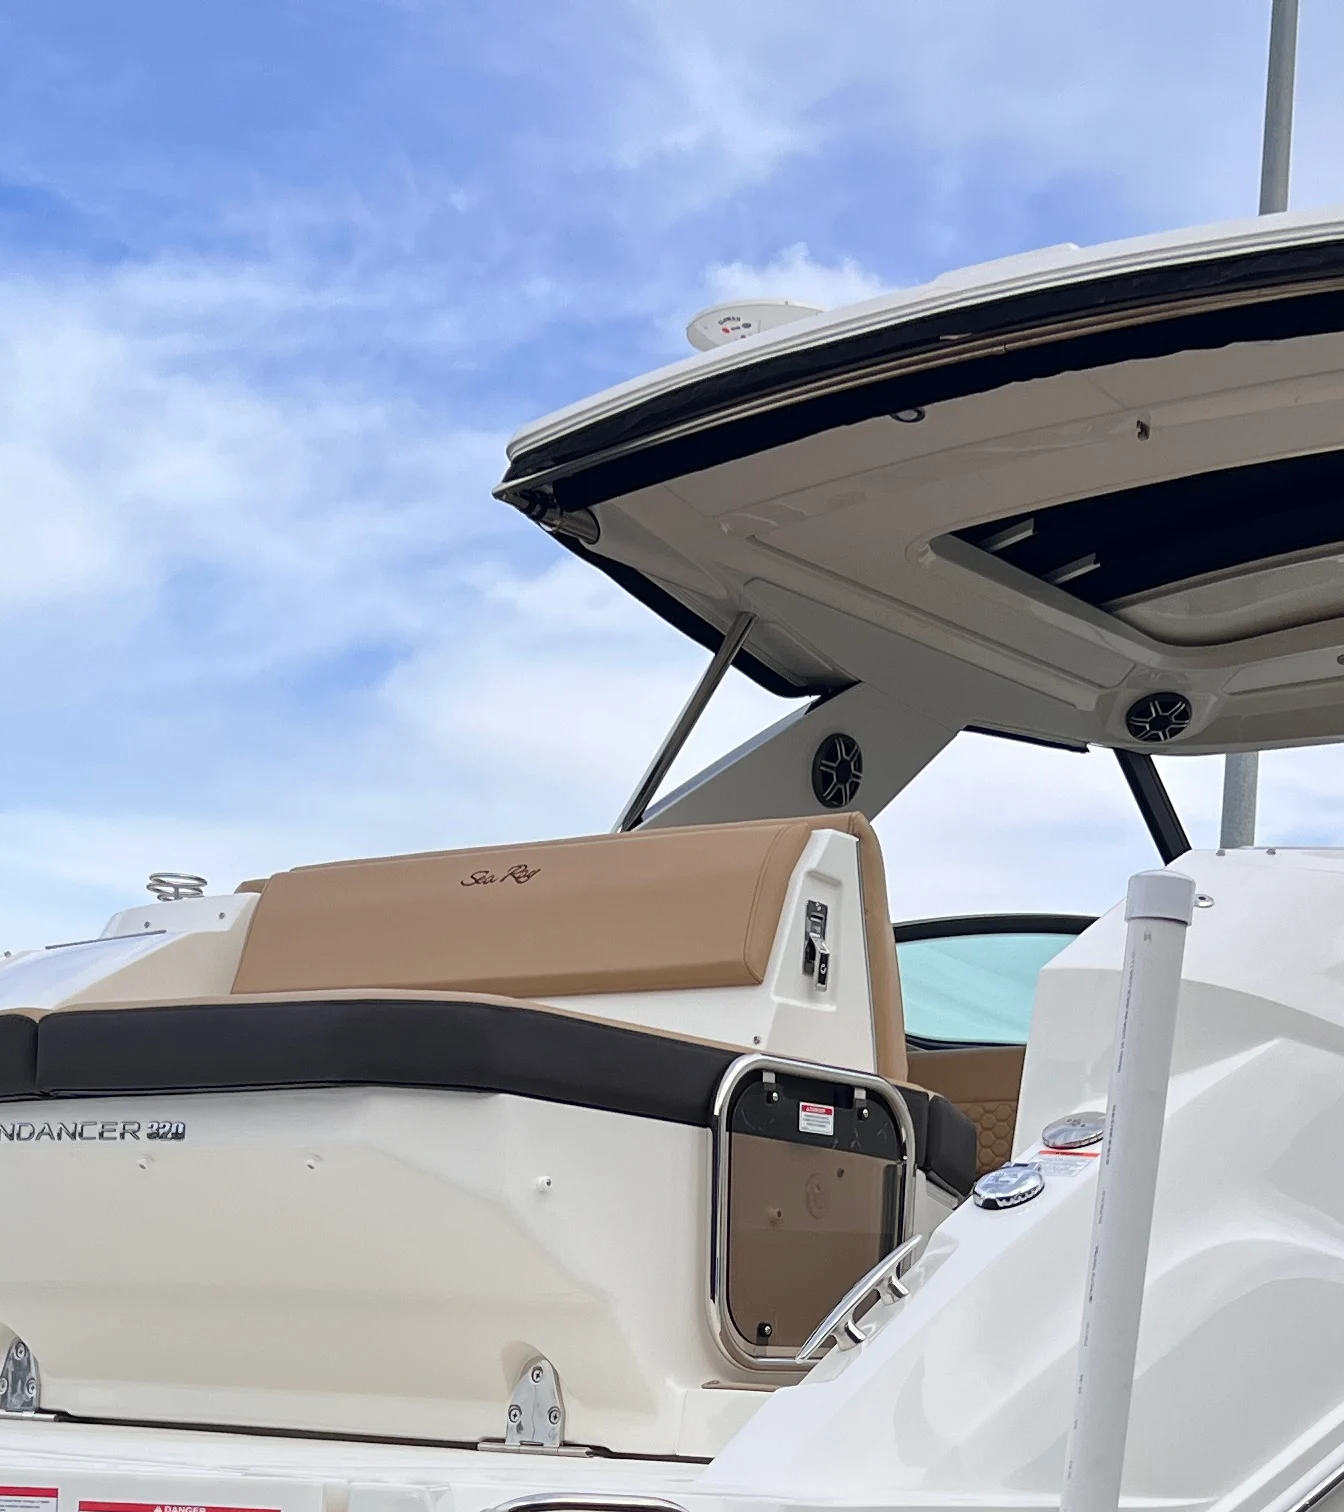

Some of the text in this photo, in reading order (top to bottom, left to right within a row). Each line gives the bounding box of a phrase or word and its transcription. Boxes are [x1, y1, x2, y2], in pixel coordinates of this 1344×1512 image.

[460, 864, 541, 887] Sea Ray
[146, 1120, 186, 1142] 320
